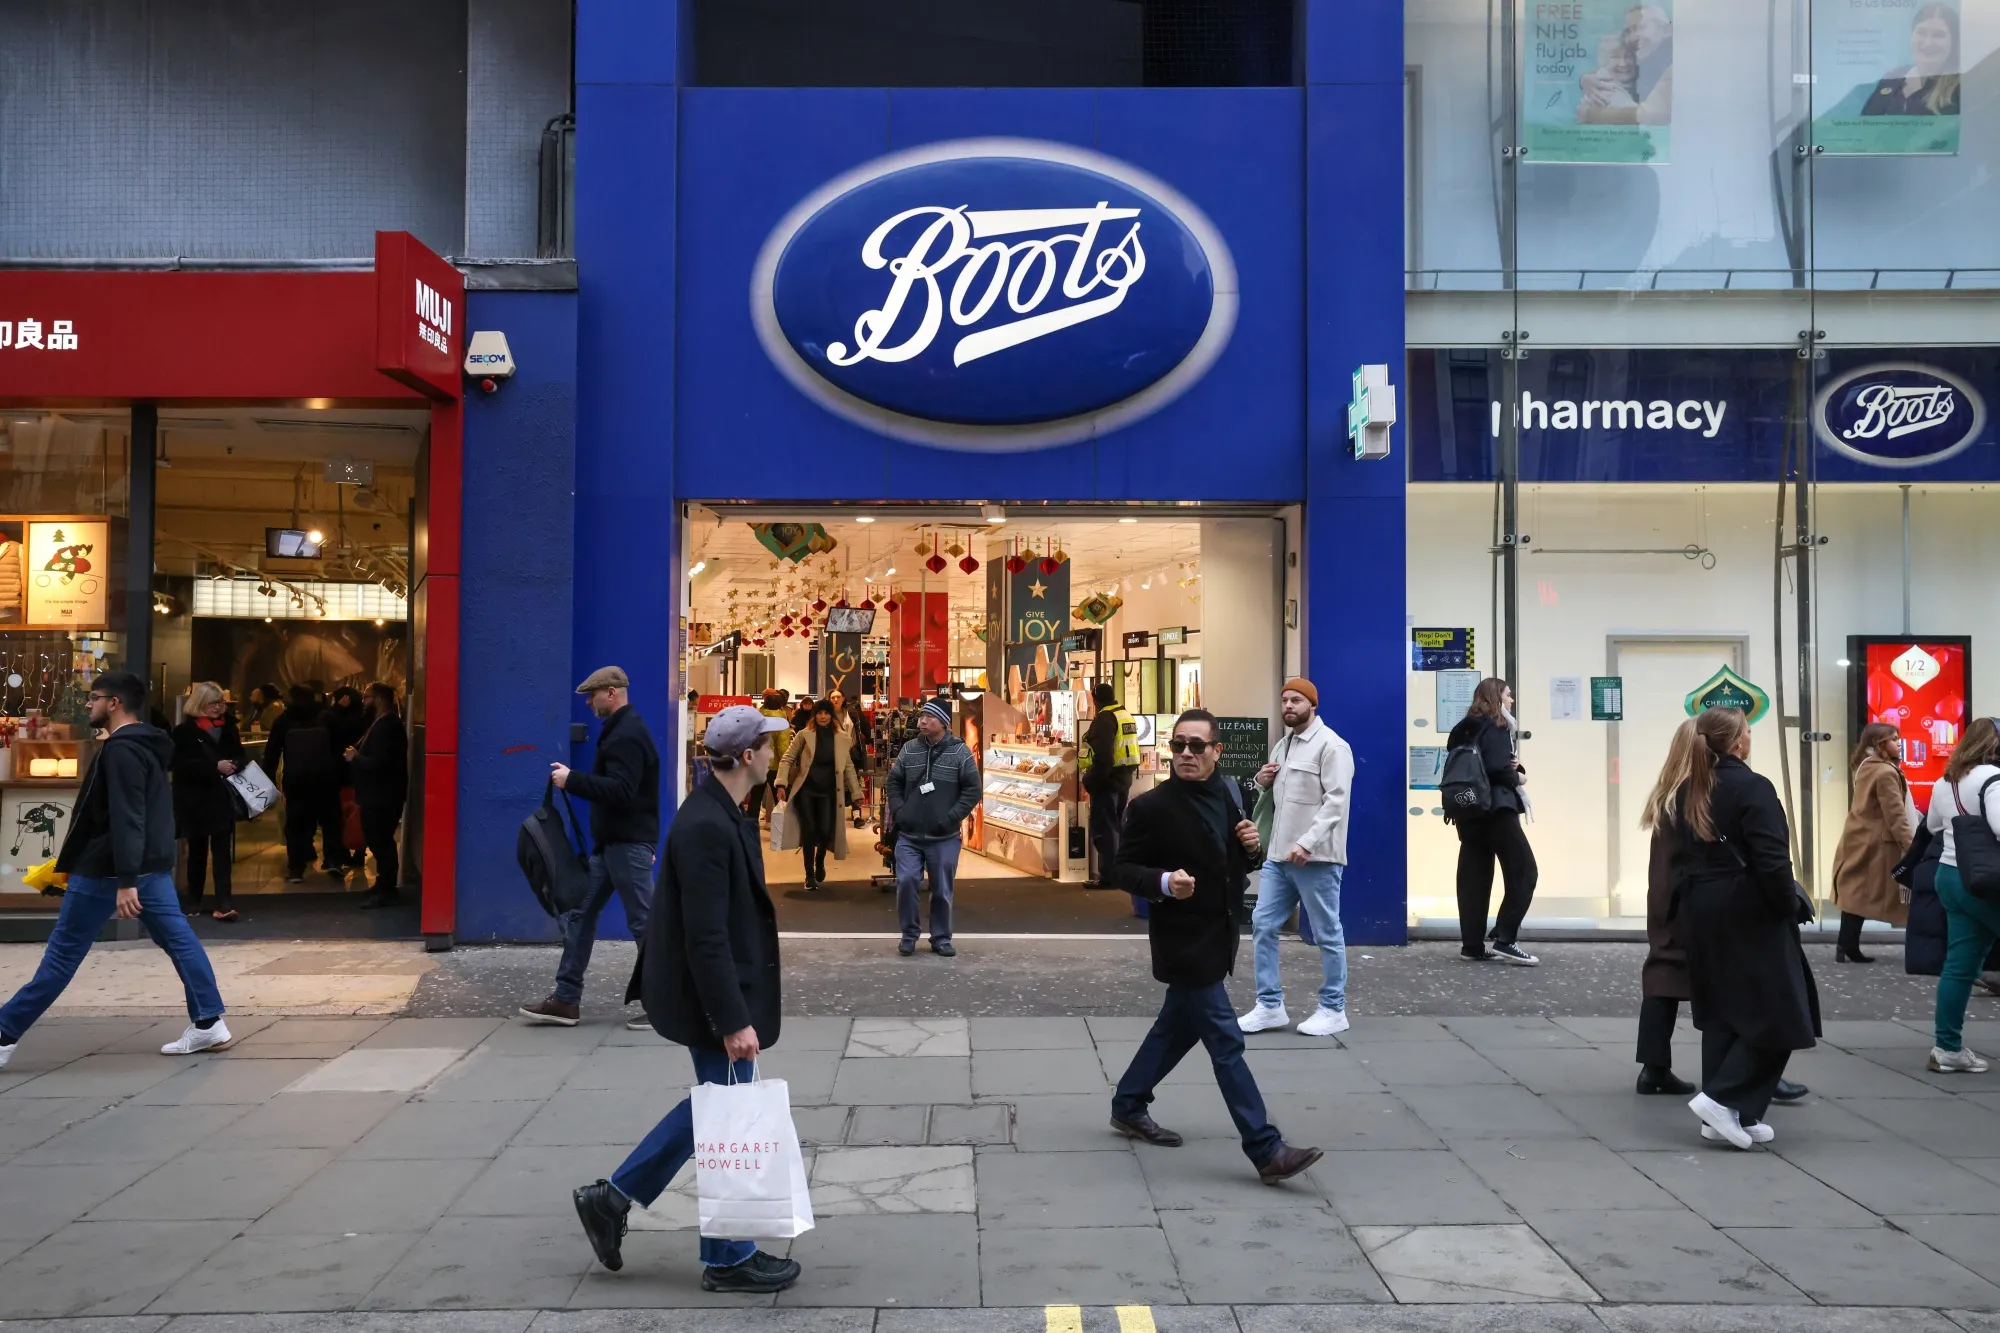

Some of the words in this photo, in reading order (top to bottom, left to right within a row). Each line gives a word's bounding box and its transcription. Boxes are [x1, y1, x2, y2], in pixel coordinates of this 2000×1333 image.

[1536, 4, 1583, 20] FREE
[1536, 24, 1578, 39] NHS
[1536, 43, 1556, 58] flu
[1558, 43, 1587, 63] jab
[1536, 64, 1575, 77] today
[826, 201, 1146, 368] Boots
[416, 278, 452, 336] MUJI
[418, 320, 448, 355] 無印良品
[469, 354, 506, 364] SECOM
[1843, 385, 1955, 440] Boots
[782, 526, 799, 537] JOY
[1017, 618, 1060, 644] JOY
[1905, 659, 1925, 671] 1/2
[1218, 722, 1232, 730] LIZ
[1234, 722, 1262, 731] EARLE
[1229, 734, 1251, 742] GIFT
[1222, 743, 1266, 751] DULGENT
[1251, 751, 1259, 759] of
[1218, 759, 1263, 768] SELF-CARE
[697, 1142, 780, 1153] MARGARET
[697, 1159, 761, 1170] HOWELL
